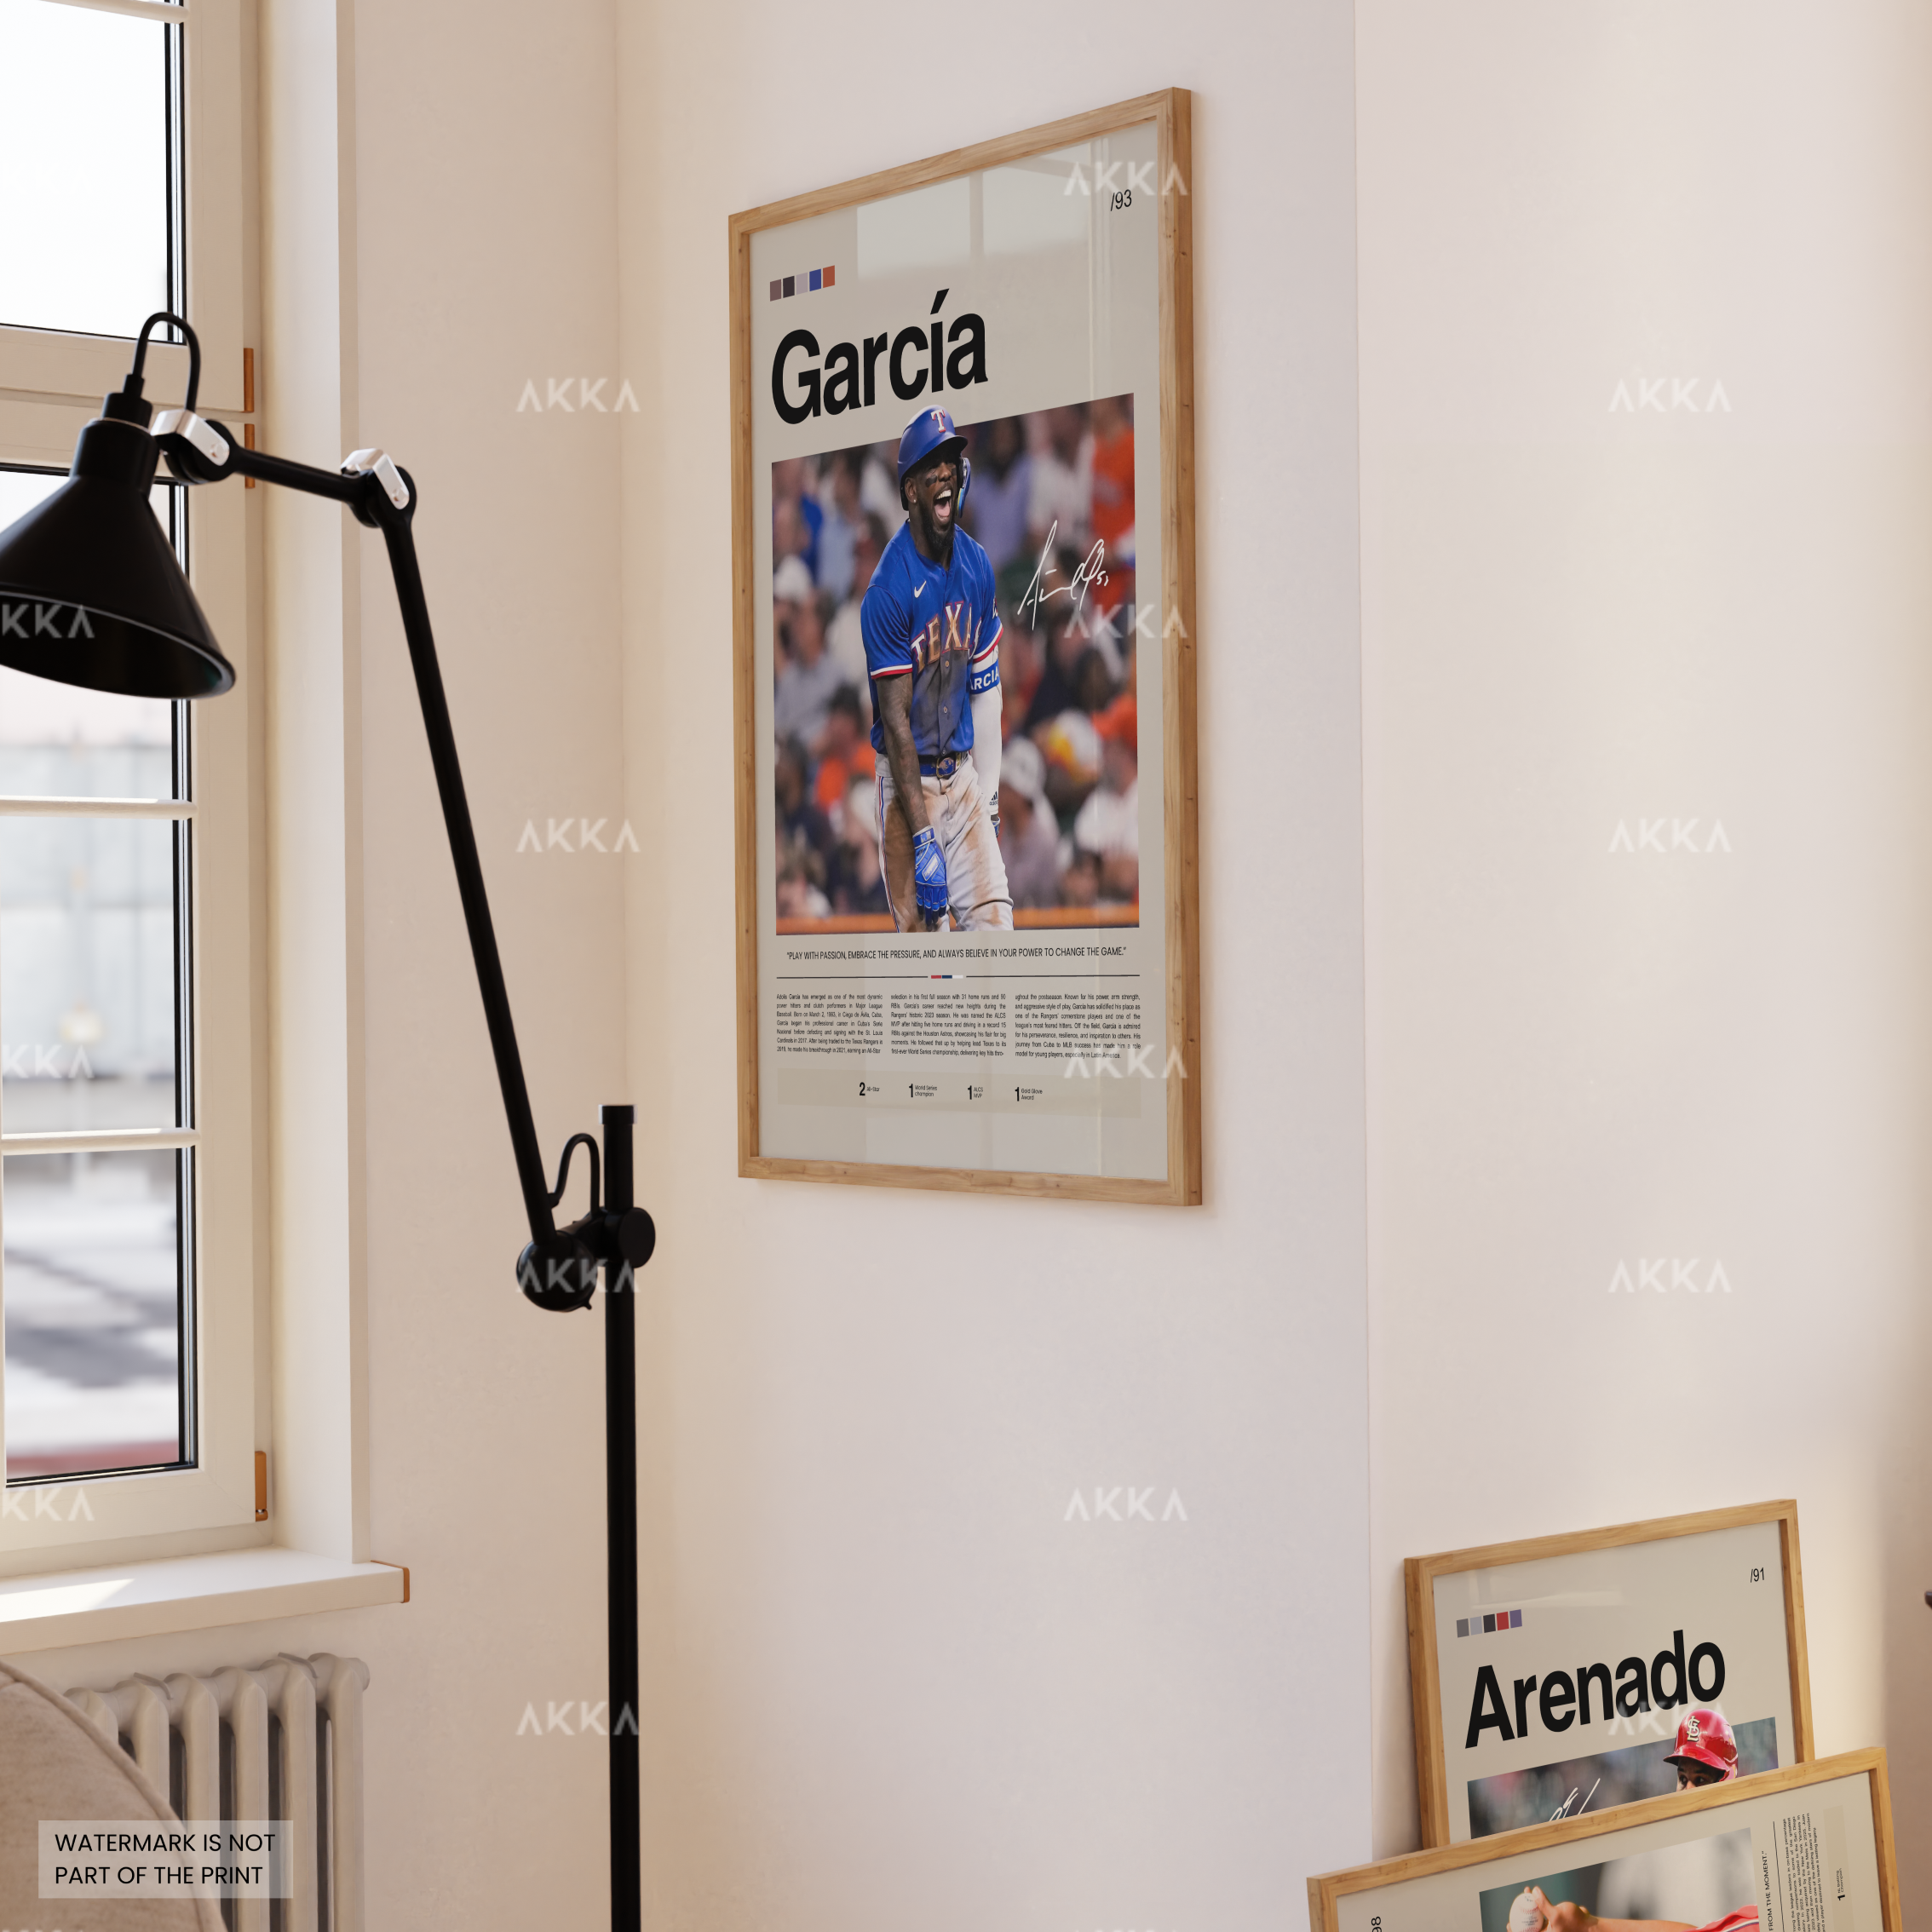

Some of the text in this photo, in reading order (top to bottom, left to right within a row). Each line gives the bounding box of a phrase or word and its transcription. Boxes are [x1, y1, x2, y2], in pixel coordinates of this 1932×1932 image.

[1110, 188, 1132, 212] /93
[771, 288, 989, 424] García
[931, 409, 946, 433] T
[804, 951, 819, 959] WITH
[820, 951, 846, 960] PASSION,
[848, 950, 876, 959] EMBRACE
[878, 950, 889, 959] THE
[890, 950, 921, 960] PRESSURE,
[923, 949, 937, 958] AND
[938, 949, 964, 958] ALWAYS
[965, 949, 989, 957] BELIEVE
[990, 949, 997, 957] IN
[999, 948, 1017, 957] YOUR
[1018, 948, 1043, 957] POWER
[1044, 948, 1054, 956] TO
[1055, 947, 1085, 956] CHANGE
[1087, 947, 1099, 956] THE
[859, 1082, 865, 1096] 2
[909, 1083, 914, 1098] 1
[968, 1085, 972, 1100] 1
[1015, 1087, 1019, 1101] 1
[1750, 1567, 1765, 1584] /91
[1465, 1629, 1726, 1749] Arenado
